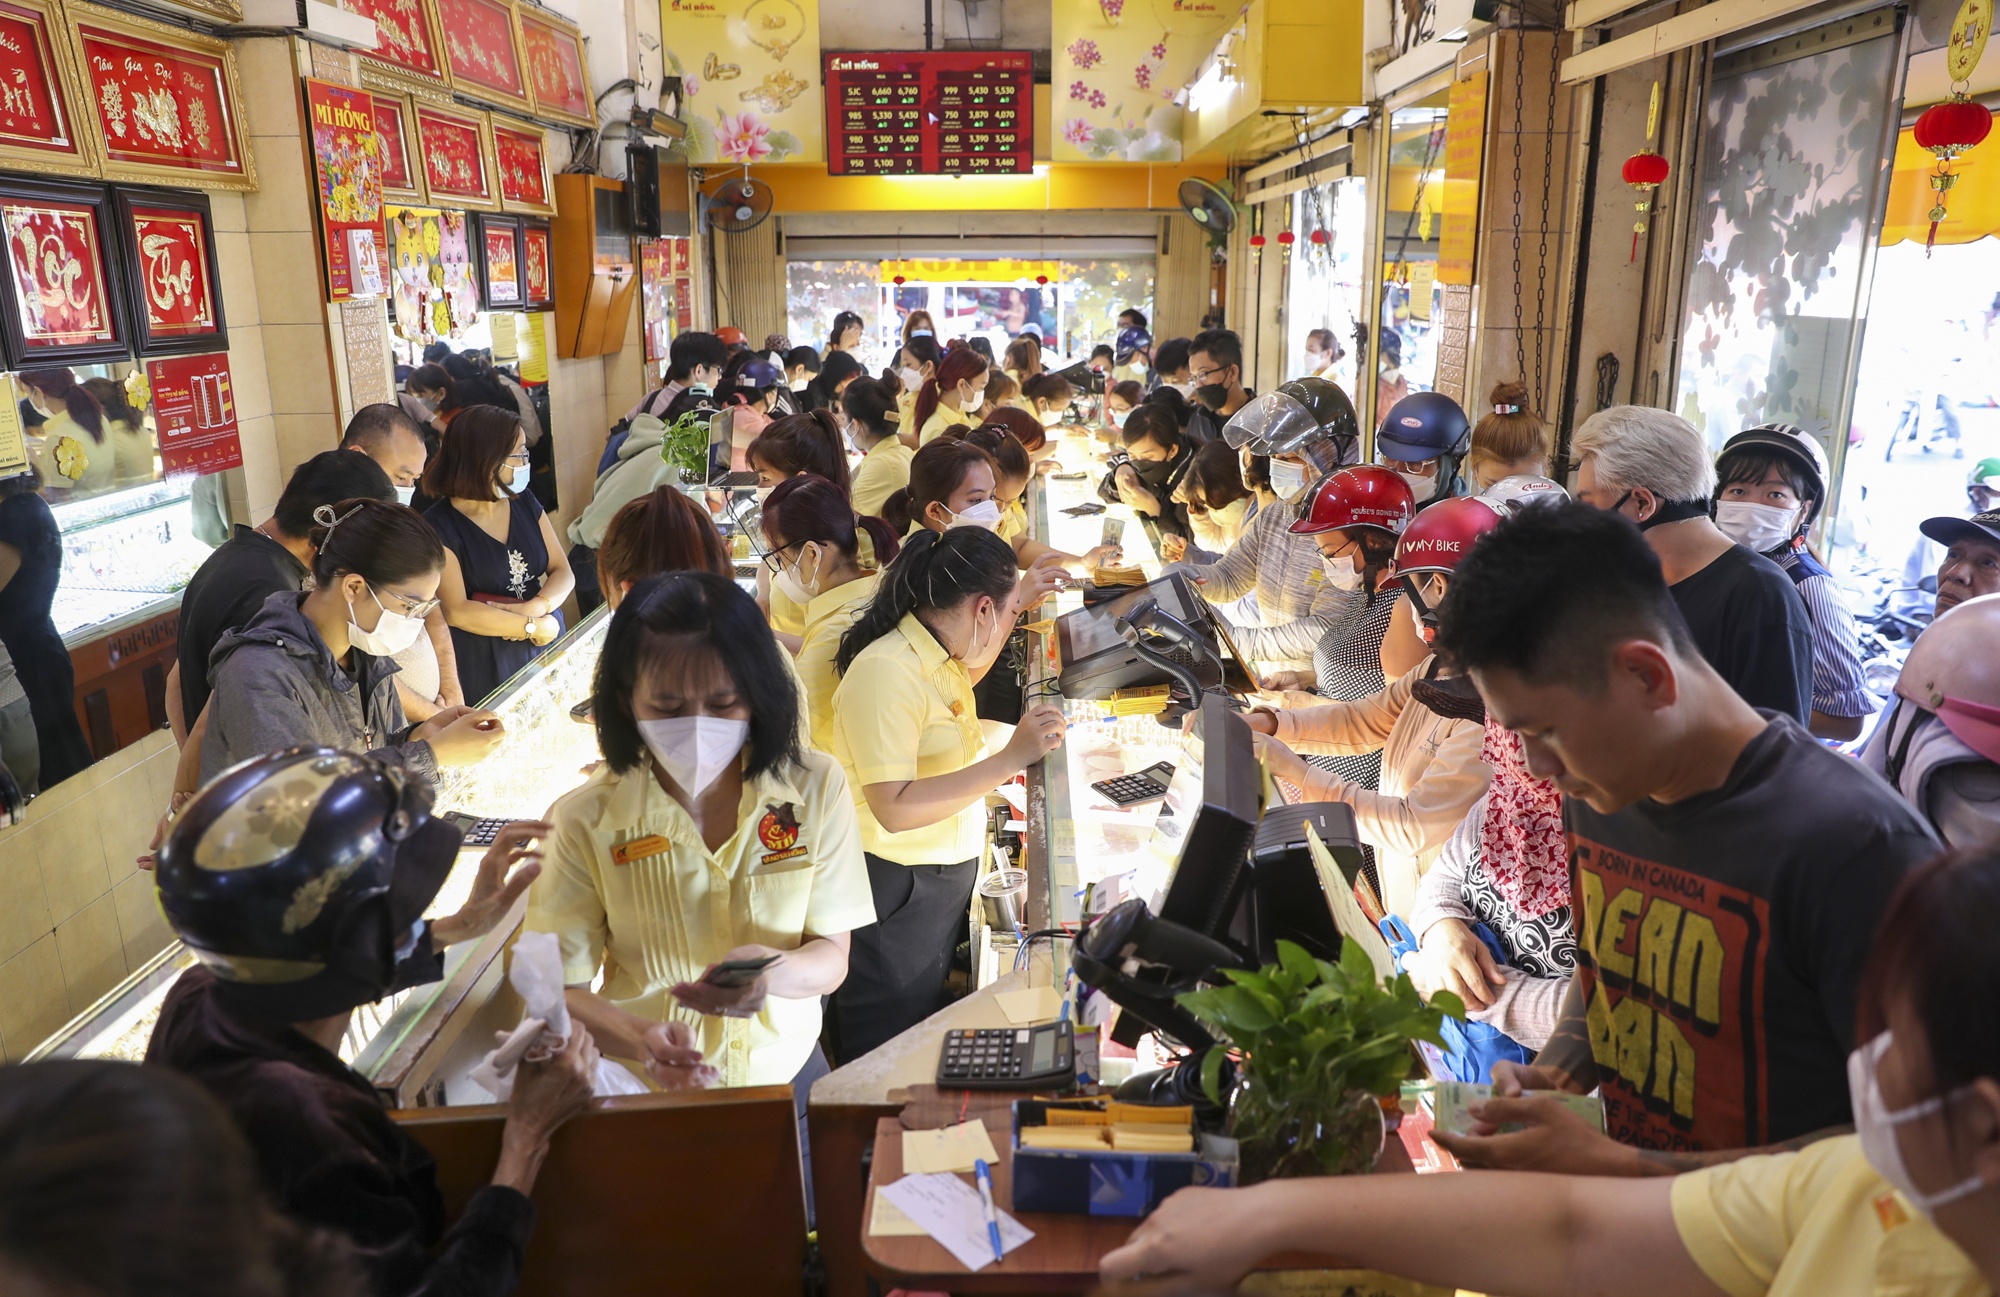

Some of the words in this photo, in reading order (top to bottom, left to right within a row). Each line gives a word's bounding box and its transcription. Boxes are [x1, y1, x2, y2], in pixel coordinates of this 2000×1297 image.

[0, 31, 22, 54] húc
[124, 56, 144, 76] Gia
[847, 87, 861, 96] SJC
[871, 87, 892, 97] 6,660
[897, 87, 919, 97] 6,760
[943, 86, 959, 95] 999
[968, 86, 989, 96] 5,430
[994, 86, 1016, 96] 5,530
[333, 99, 371, 131] HỒNG
[848, 111, 862, 120] 985
[872, 111, 893, 120] 5,330
[898, 111, 919, 120] 5,430
[945, 110, 959, 119] 750
[968, 110, 989, 120] 3,870
[994, 110, 1015, 120] 4,070
[849, 135, 864, 144] 980
[873, 135, 894, 144] 5,300
[898, 135, 920, 145] 5,400
[944, 134, 960, 143] 680
[968, 134, 989, 144] 3,390
[994, 134, 1015, 144] 3,560
[850, 159, 864, 168] 950
[873, 159, 894, 168] 5,100
[906, 158, 913, 167] 0
[945, 158, 960, 167] 610
[968, 158, 990, 168] 3,290
[994, 158, 1016, 168] 3,460
[359, 241, 375, 266] 31
[1376, 509, 1393, 517] GOING
[1392, 510, 1400, 518] TO
[1415, 538, 1435, 552] MY
[1436, 539, 1461, 552] BIKE
[1597, 851, 1630, 875] BORN
[1632, 863, 1648, 881] IN
[1650, 870, 1706, 900] CANADA
